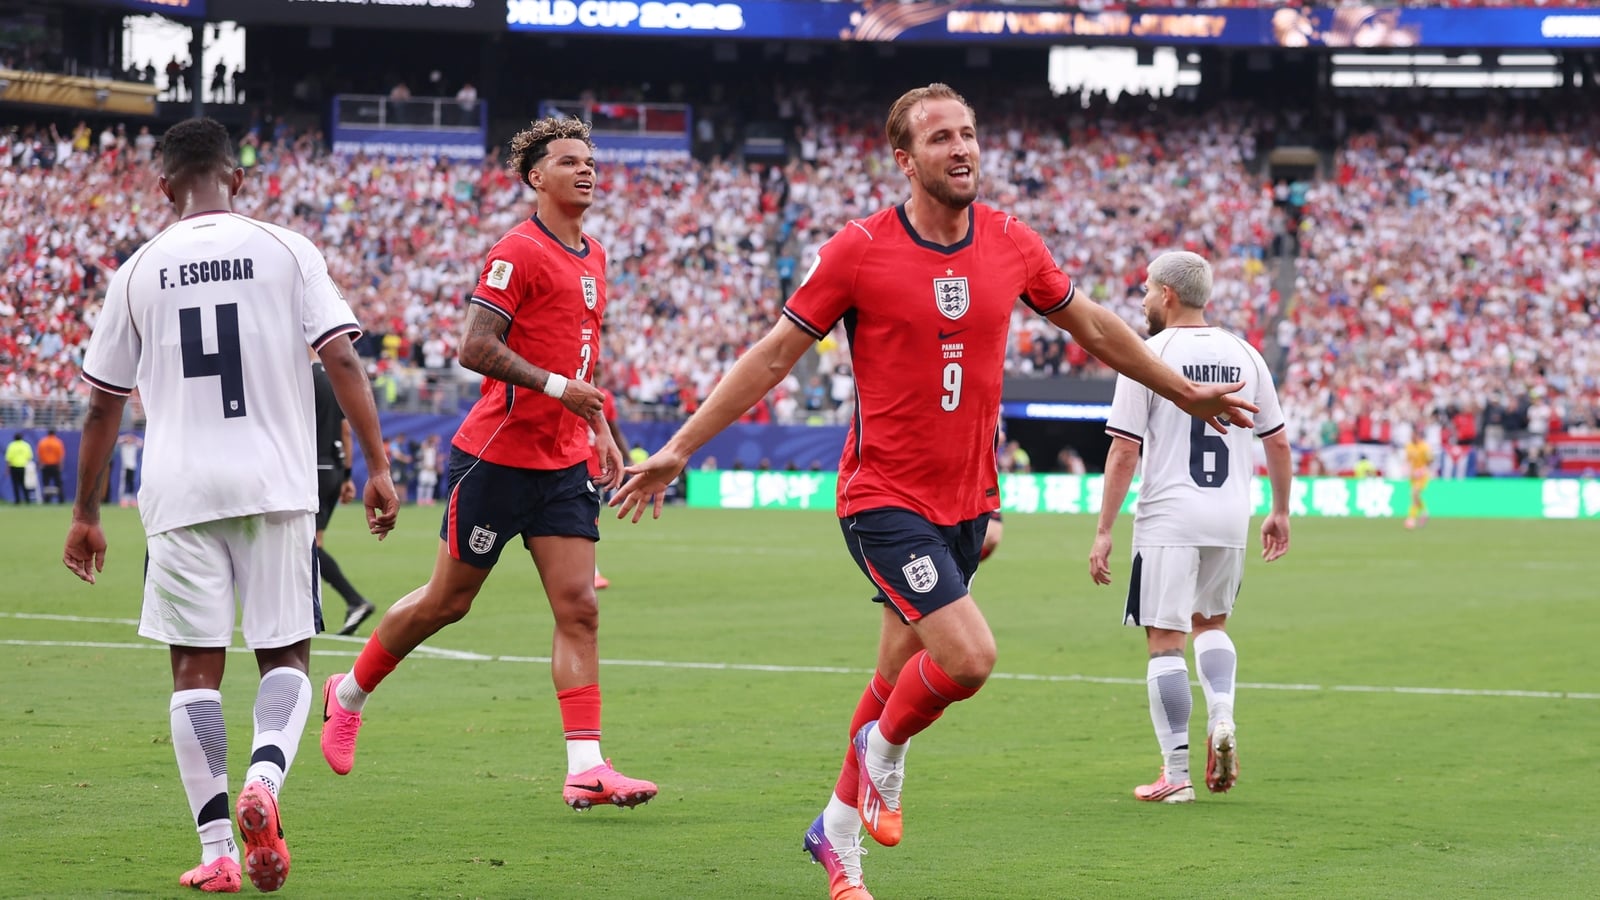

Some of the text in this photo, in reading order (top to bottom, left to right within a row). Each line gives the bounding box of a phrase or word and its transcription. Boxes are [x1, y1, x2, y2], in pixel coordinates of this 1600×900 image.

[578, 1, 639, 27] CUP
[159, 258, 255, 290] F. ESCOBAR
[179, 302, 247, 419] 4
[575, 343, 592, 381] 3
[941, 343, 964, 351] PANAMA
[941, 362, 963, 412] 9
[1182, 361, 1242, 383] MARTÍNEZ
[1189, 410, 1230, 488] 6
